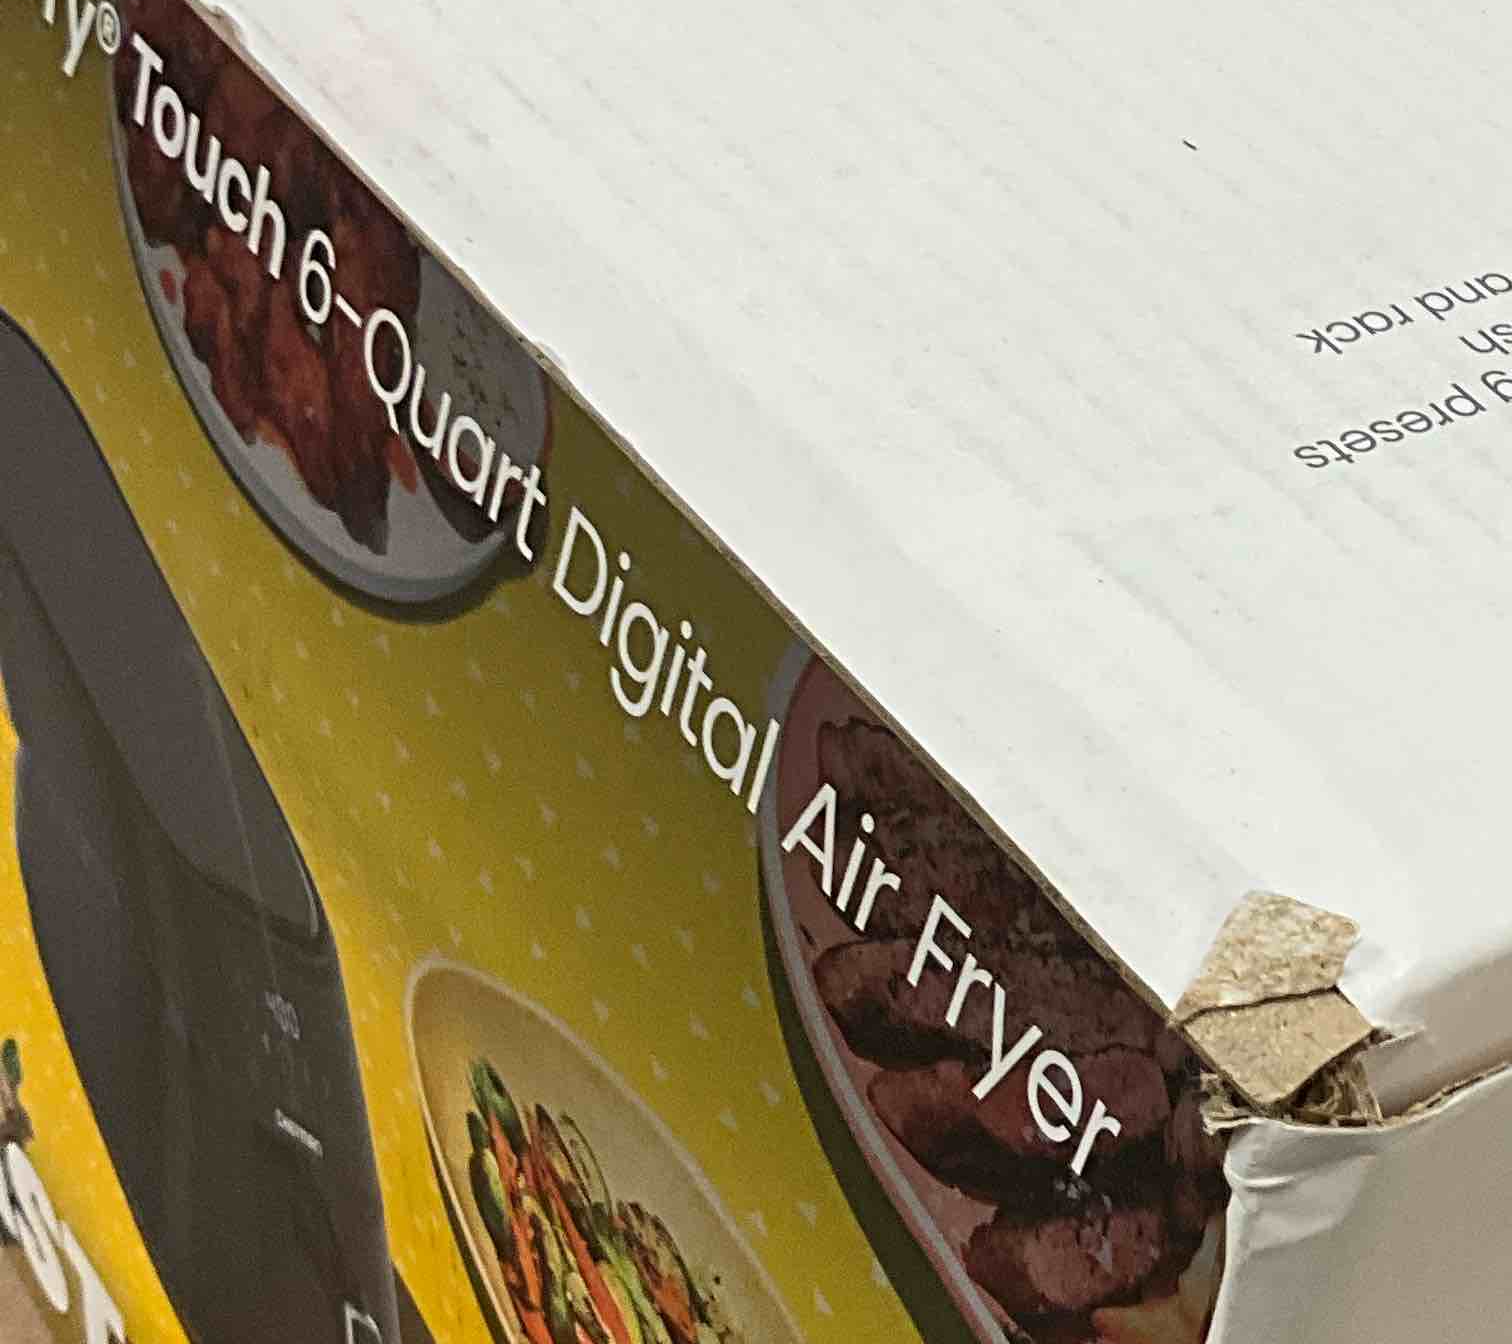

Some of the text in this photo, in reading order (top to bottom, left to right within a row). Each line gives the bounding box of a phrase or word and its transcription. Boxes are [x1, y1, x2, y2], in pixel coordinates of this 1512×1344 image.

[1295, 303, 1413, 357] rack
[1293, 383, 1487, 473] presets
[128, 33, 287, 281] Touch
[299, 228, 547, 561] 6-Quart
[552, 506, 780, 816] Digital
[780, 782, 901, 933] Air
[905, 893, 1124, 1176] Fryer
